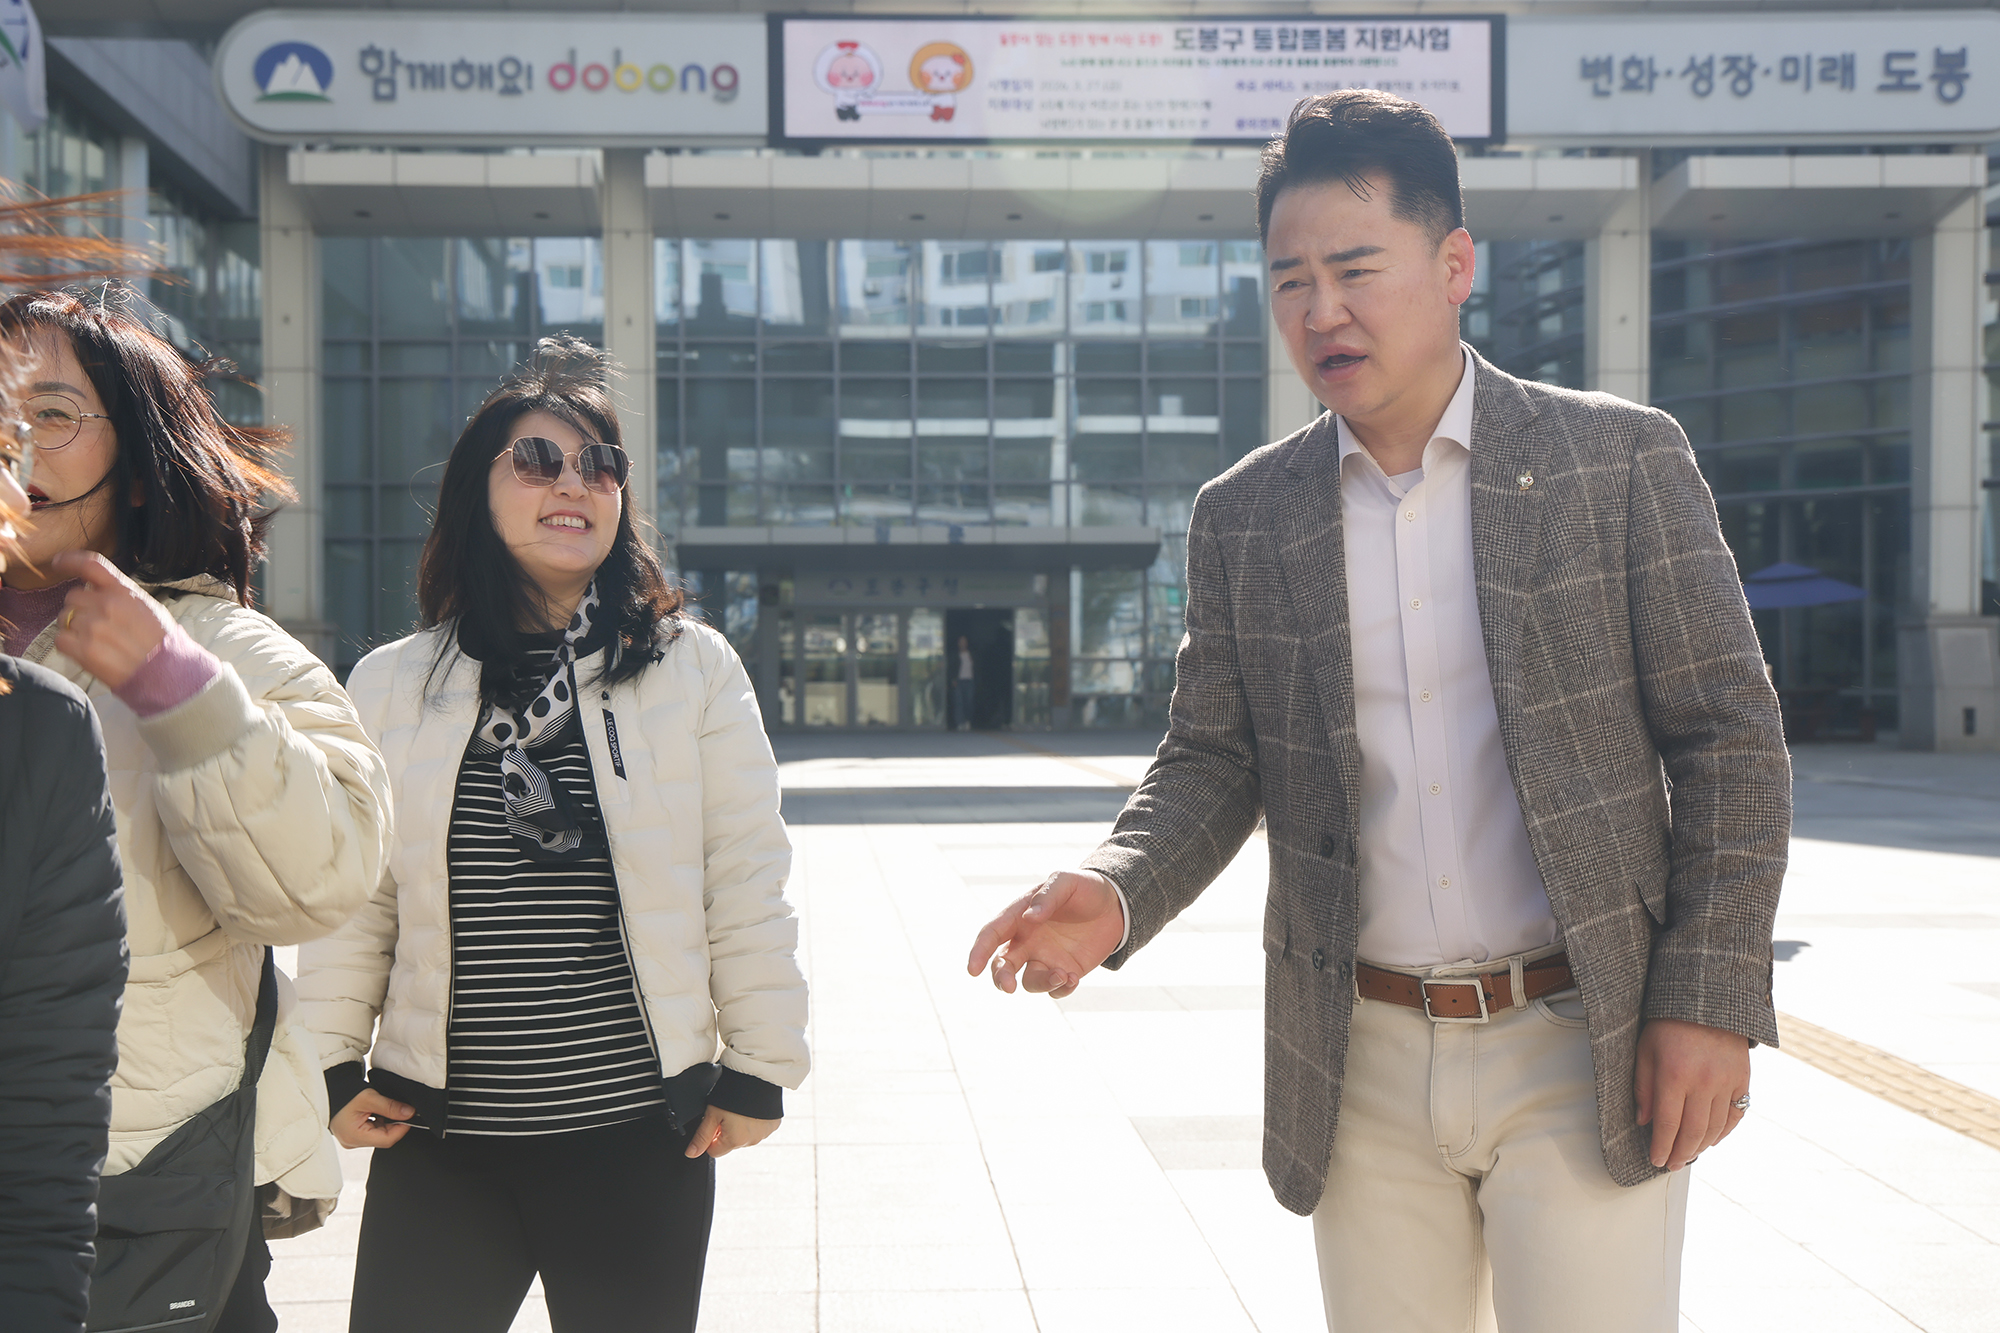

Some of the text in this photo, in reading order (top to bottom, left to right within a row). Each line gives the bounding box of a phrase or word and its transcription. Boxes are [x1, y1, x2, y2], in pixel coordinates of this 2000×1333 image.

[1173, 27, 1450, 52] 도봉구 통합돌봄 지원사업
[548, 47, 740, 103] dobong
[1579, 46, 1972, 104] 변화·성장·미래 도봉
[606, 718, 613, 726] LE
[610, 742, 622, 767] SPORTIF
